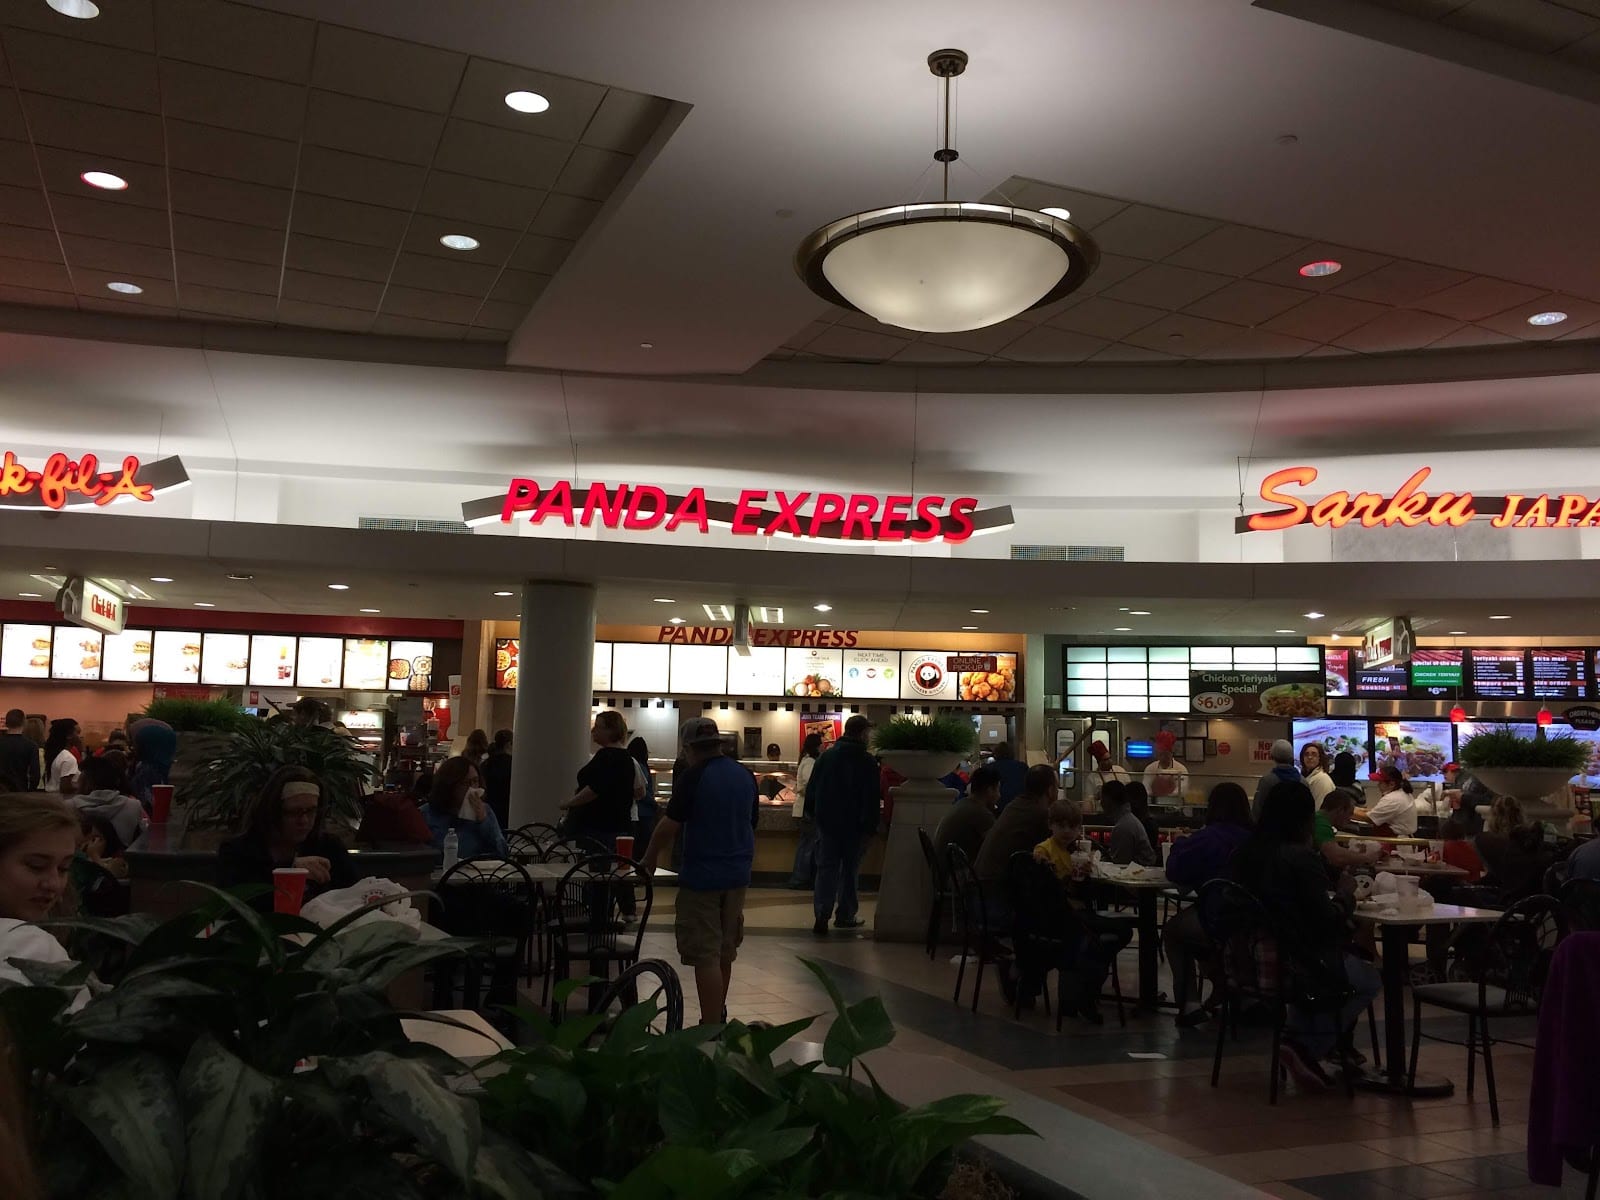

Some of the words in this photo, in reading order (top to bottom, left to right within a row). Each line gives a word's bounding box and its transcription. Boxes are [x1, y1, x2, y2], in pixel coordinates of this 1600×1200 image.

[0, 452, 154, 509] k-fil-A
[1248, 466, 1476, 531] Sarku
[500, 478, 709, 534] PANDA
[732, 489, 978, 545] EXPRESS
[658, 626, 734, 644] PAND
[753, 628, 859, 647] EXPRESS
[1202, 673, 1239, 683] Chicken
[1240, 674, 1277, 685] Teriyaki
[1221, 684, 1258, 694] Special!
[1197, 696, 1231, 709] $6.09
[1258, 741, 1273, 750] No
